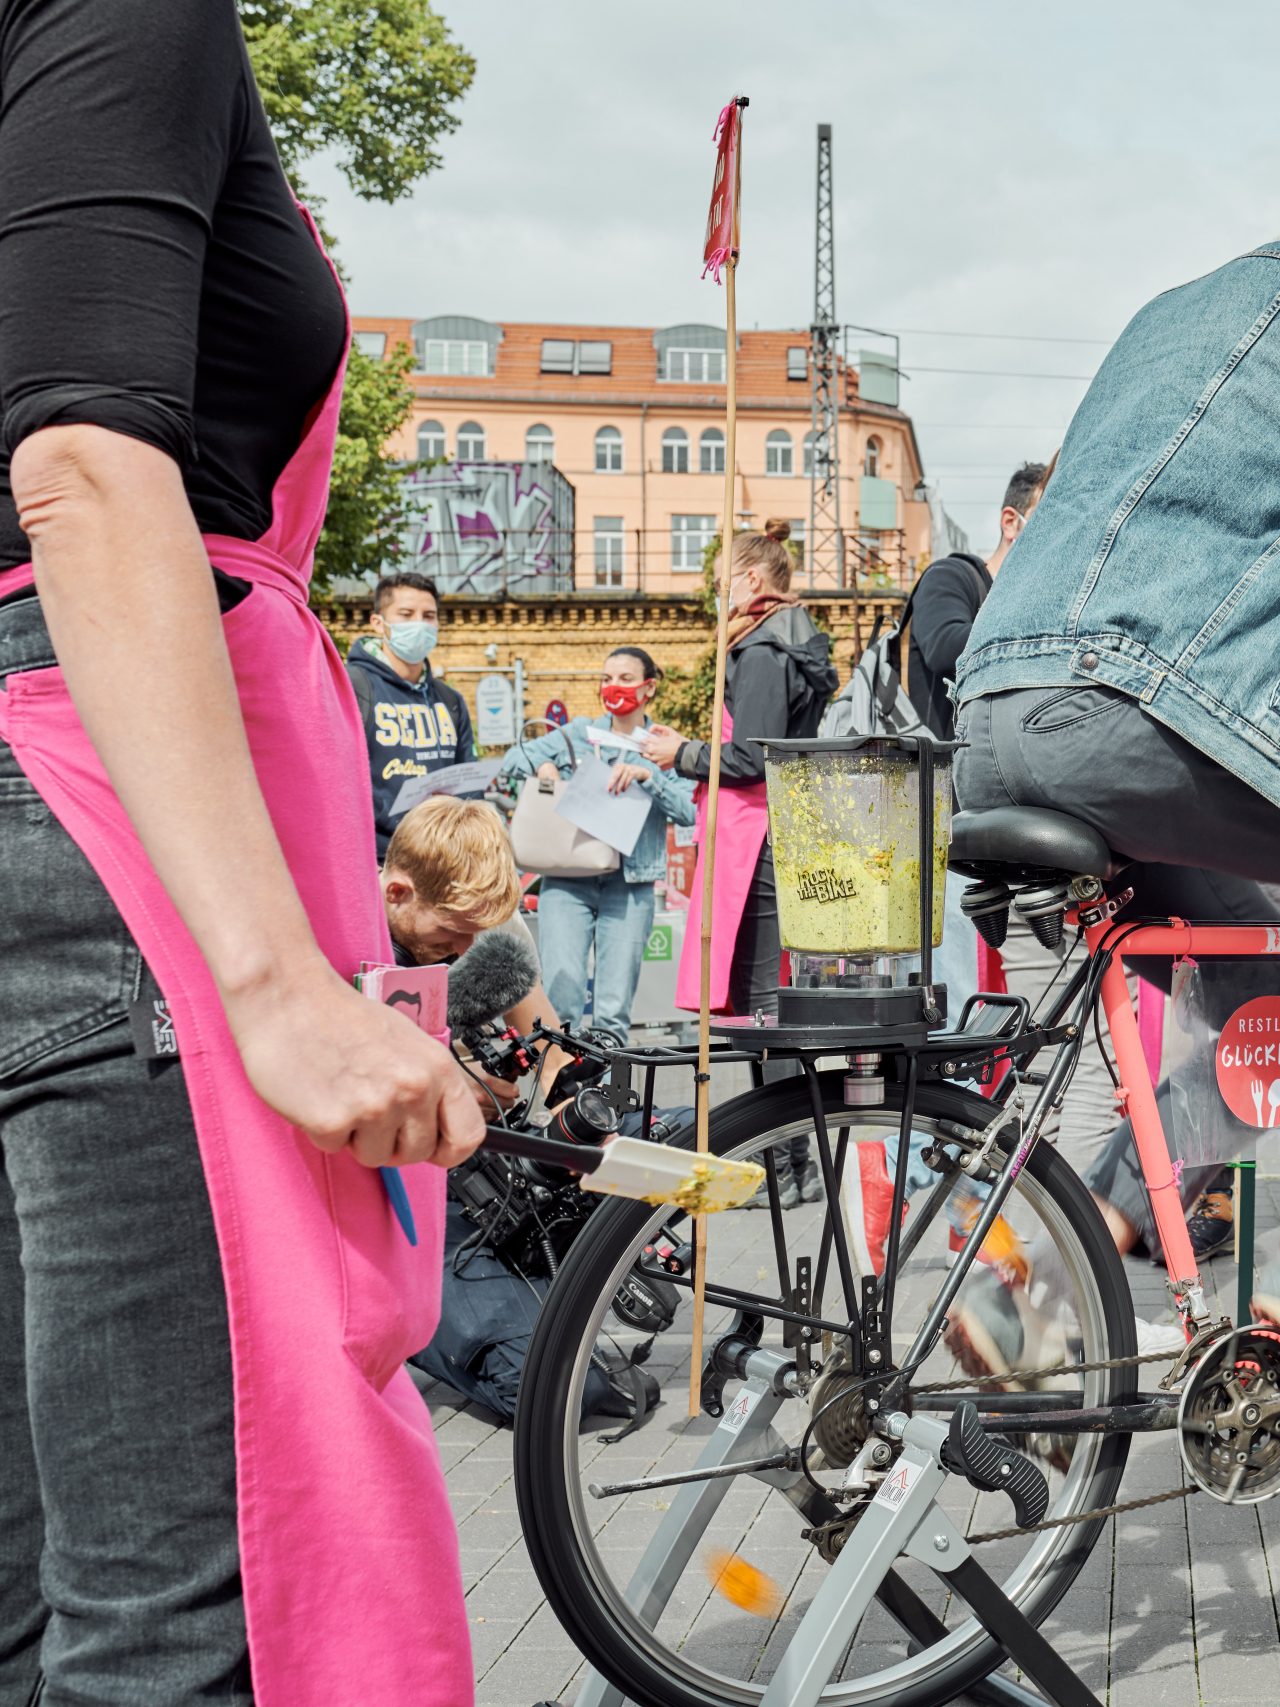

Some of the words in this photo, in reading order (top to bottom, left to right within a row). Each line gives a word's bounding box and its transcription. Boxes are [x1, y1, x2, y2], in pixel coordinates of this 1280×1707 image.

[374, 702, 457, 748] SEDA
[797, 886, 818, 901] THE
[814, 877, 857, 904] BIKE
[798, 868, 837, 889] ROCK
[629, 1283, 654, 1307] Canon
